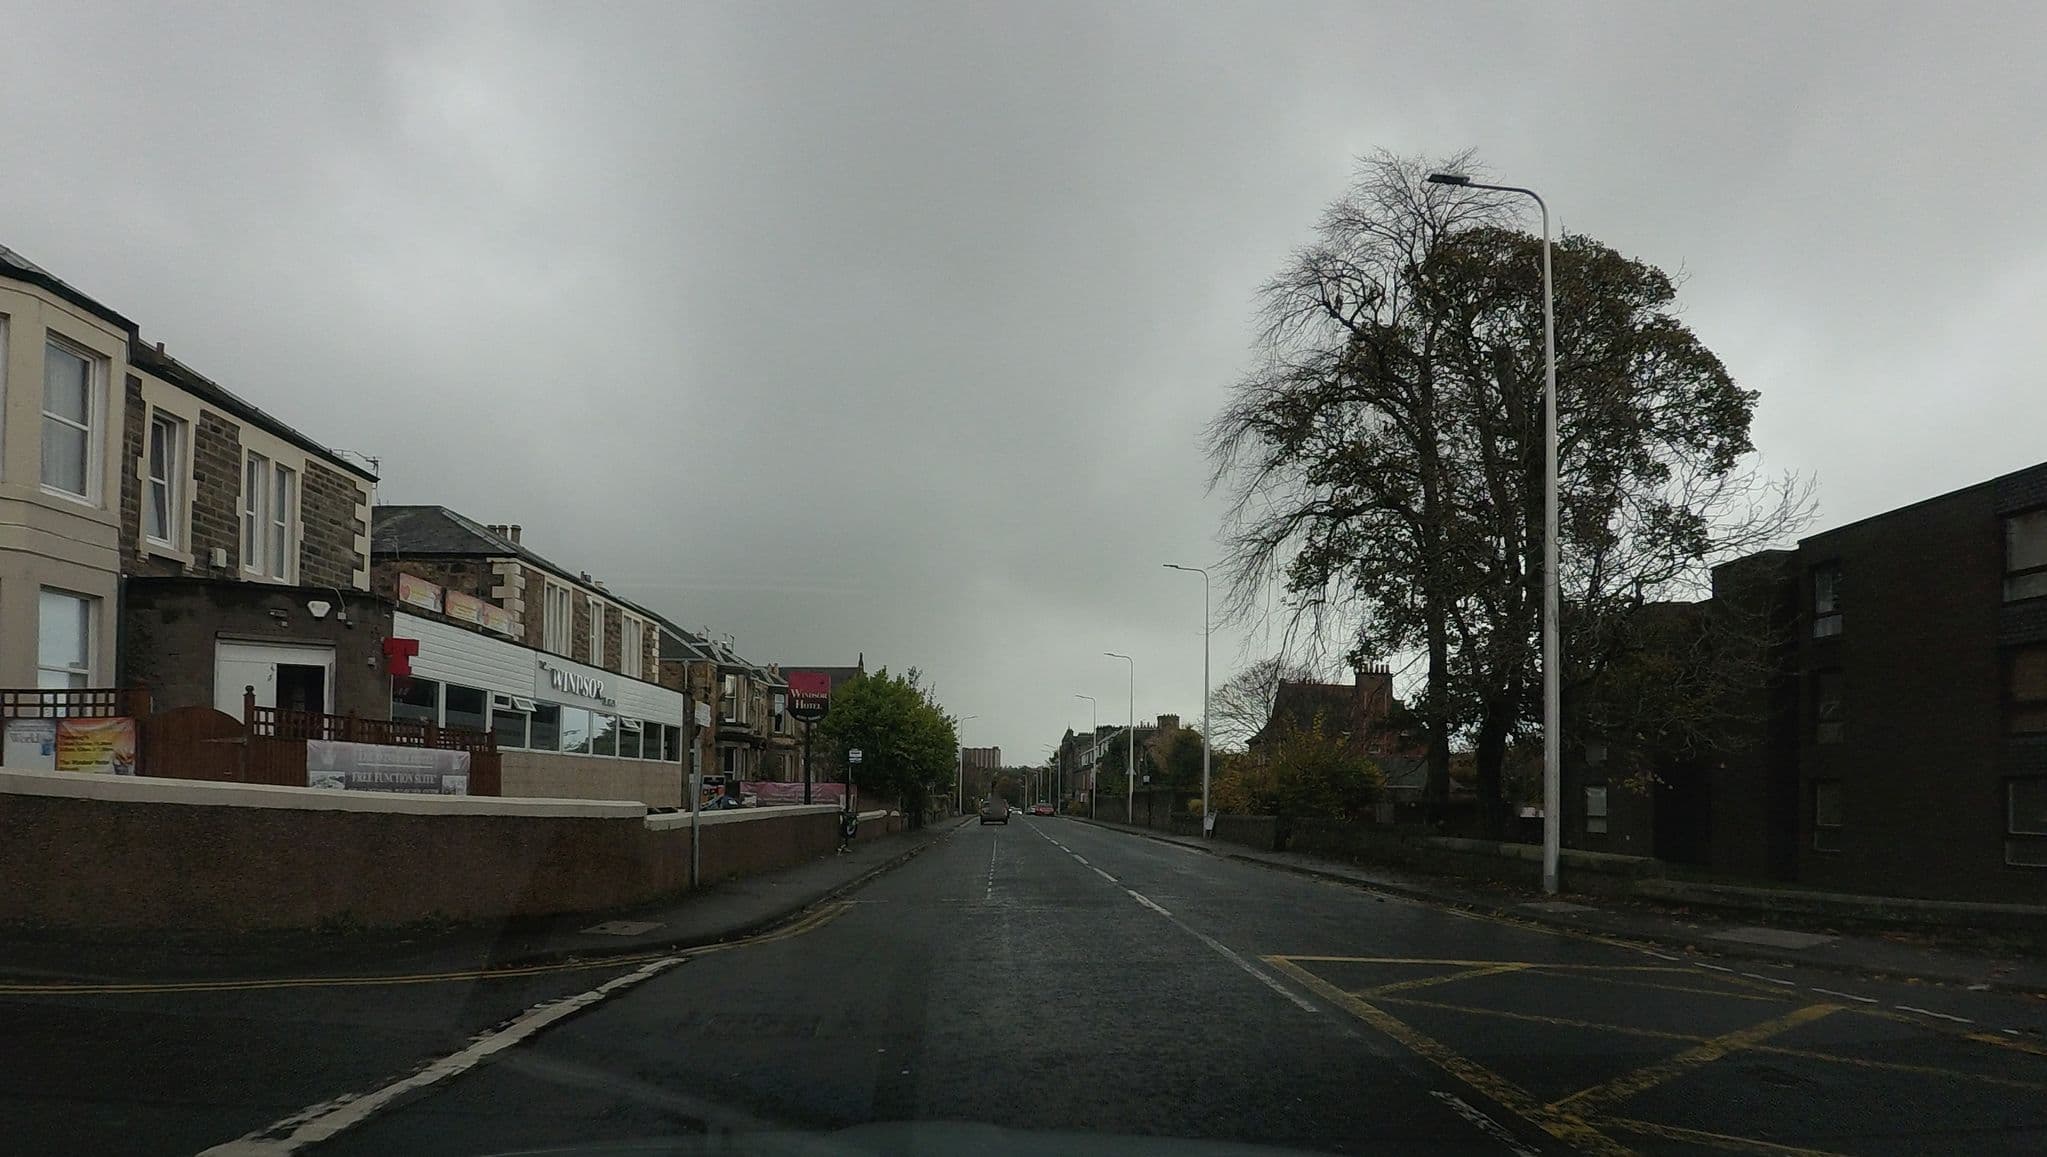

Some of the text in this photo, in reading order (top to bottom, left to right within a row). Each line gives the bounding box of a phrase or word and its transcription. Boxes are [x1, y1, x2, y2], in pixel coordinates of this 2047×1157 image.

[549, 668, 604, 698] WINDSOR
[791, 688, 827, 699] WINDSOR
[795, 699, 823, 709] HOTEL
[352, 771, 436, 784] FREE FUNCTION SUITE
